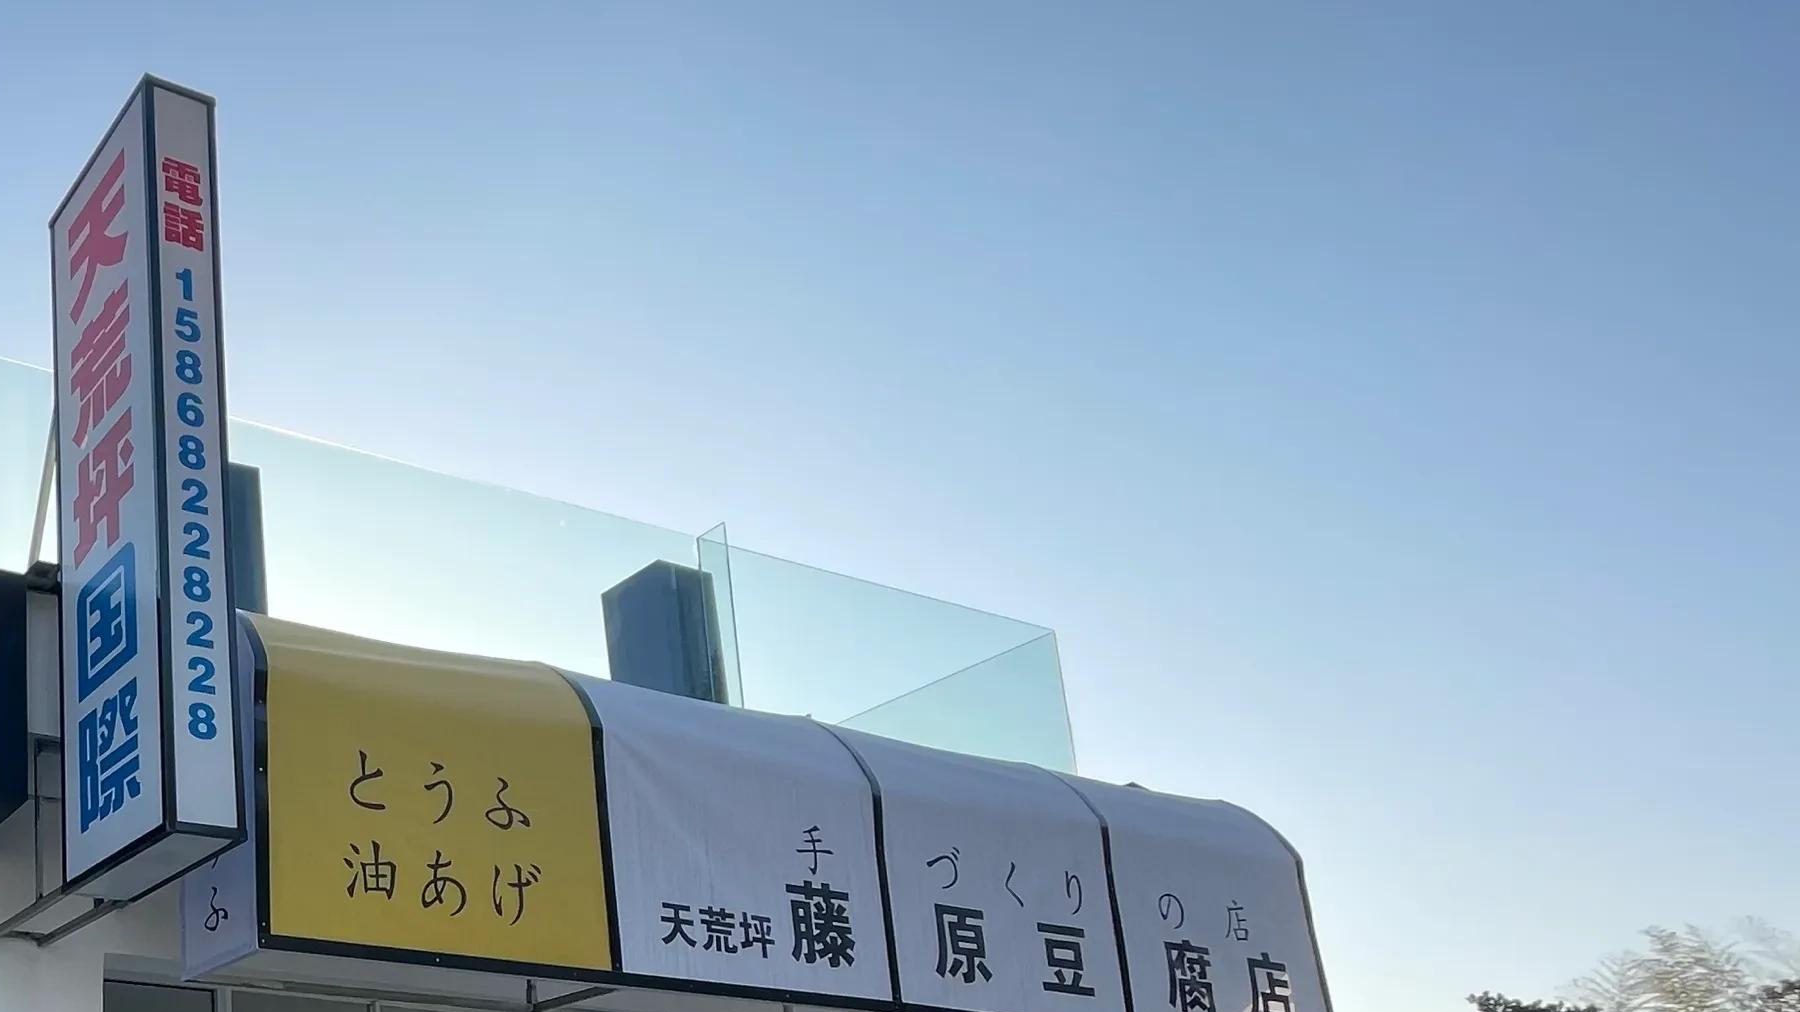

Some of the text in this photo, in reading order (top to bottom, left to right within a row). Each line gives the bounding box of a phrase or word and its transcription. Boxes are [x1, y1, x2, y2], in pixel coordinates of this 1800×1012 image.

[67, 146, 141, 835] 天荒坪国際
[161, 156, 218, 741] 電話 15868228228
[349, 749, 531, 830] とうふ
[343, 840, 542, 927] 油あげ
[660, 902, 775, 959] 天荒坪
